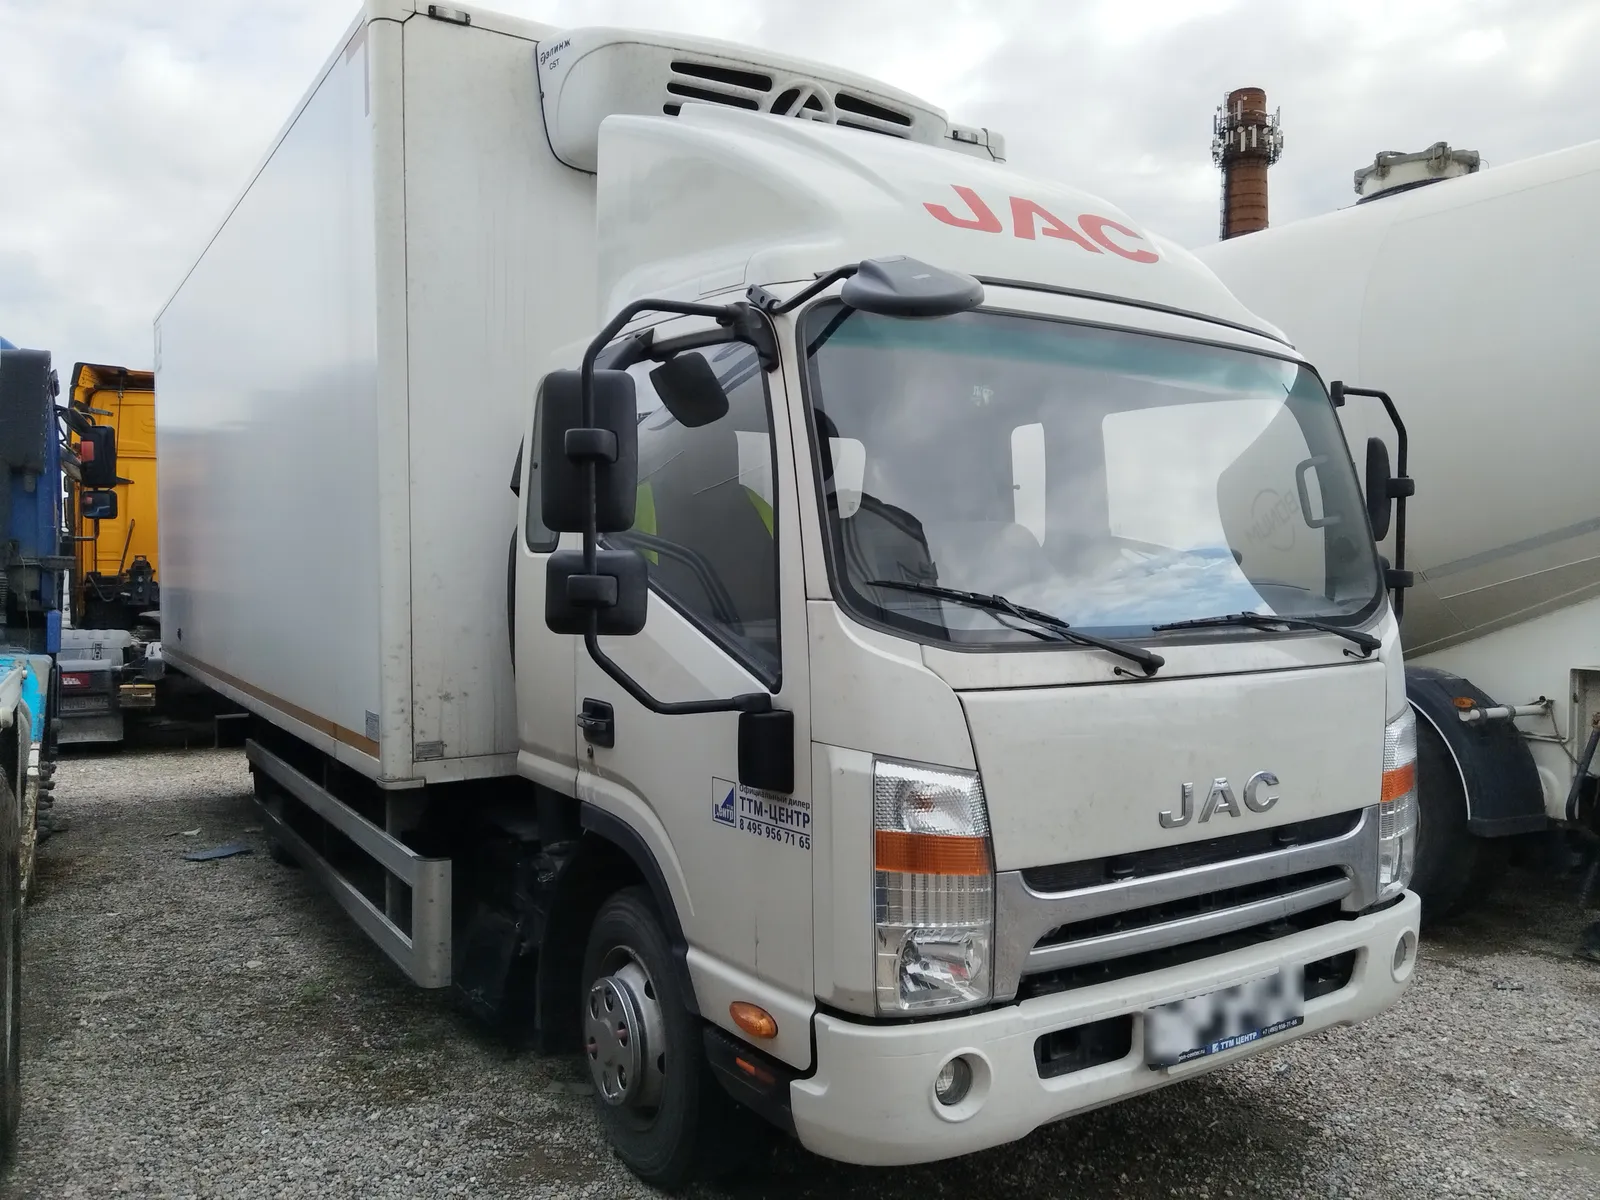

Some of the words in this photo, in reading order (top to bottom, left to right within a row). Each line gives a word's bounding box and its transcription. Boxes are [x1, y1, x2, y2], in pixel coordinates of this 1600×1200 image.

[922, 184, 1159, 264] JAC
[739, 796, 811, 829] ТТМ-ЦЕНТР
[787, 797, 811, 811] дилер
[1158, 770, 1280, 829] JAC
[739, 818, 745, 831] 8
[747, 820, 763, 836] 495
[765, 826, 782, 842] 956
[784, 831, 795, 846] 71
[798, 836, 811, 850] 65
[1220, 1039, 1235, 1050] ТТМ
[1235, 1031, 1258, 1045] ЦЕНТР
